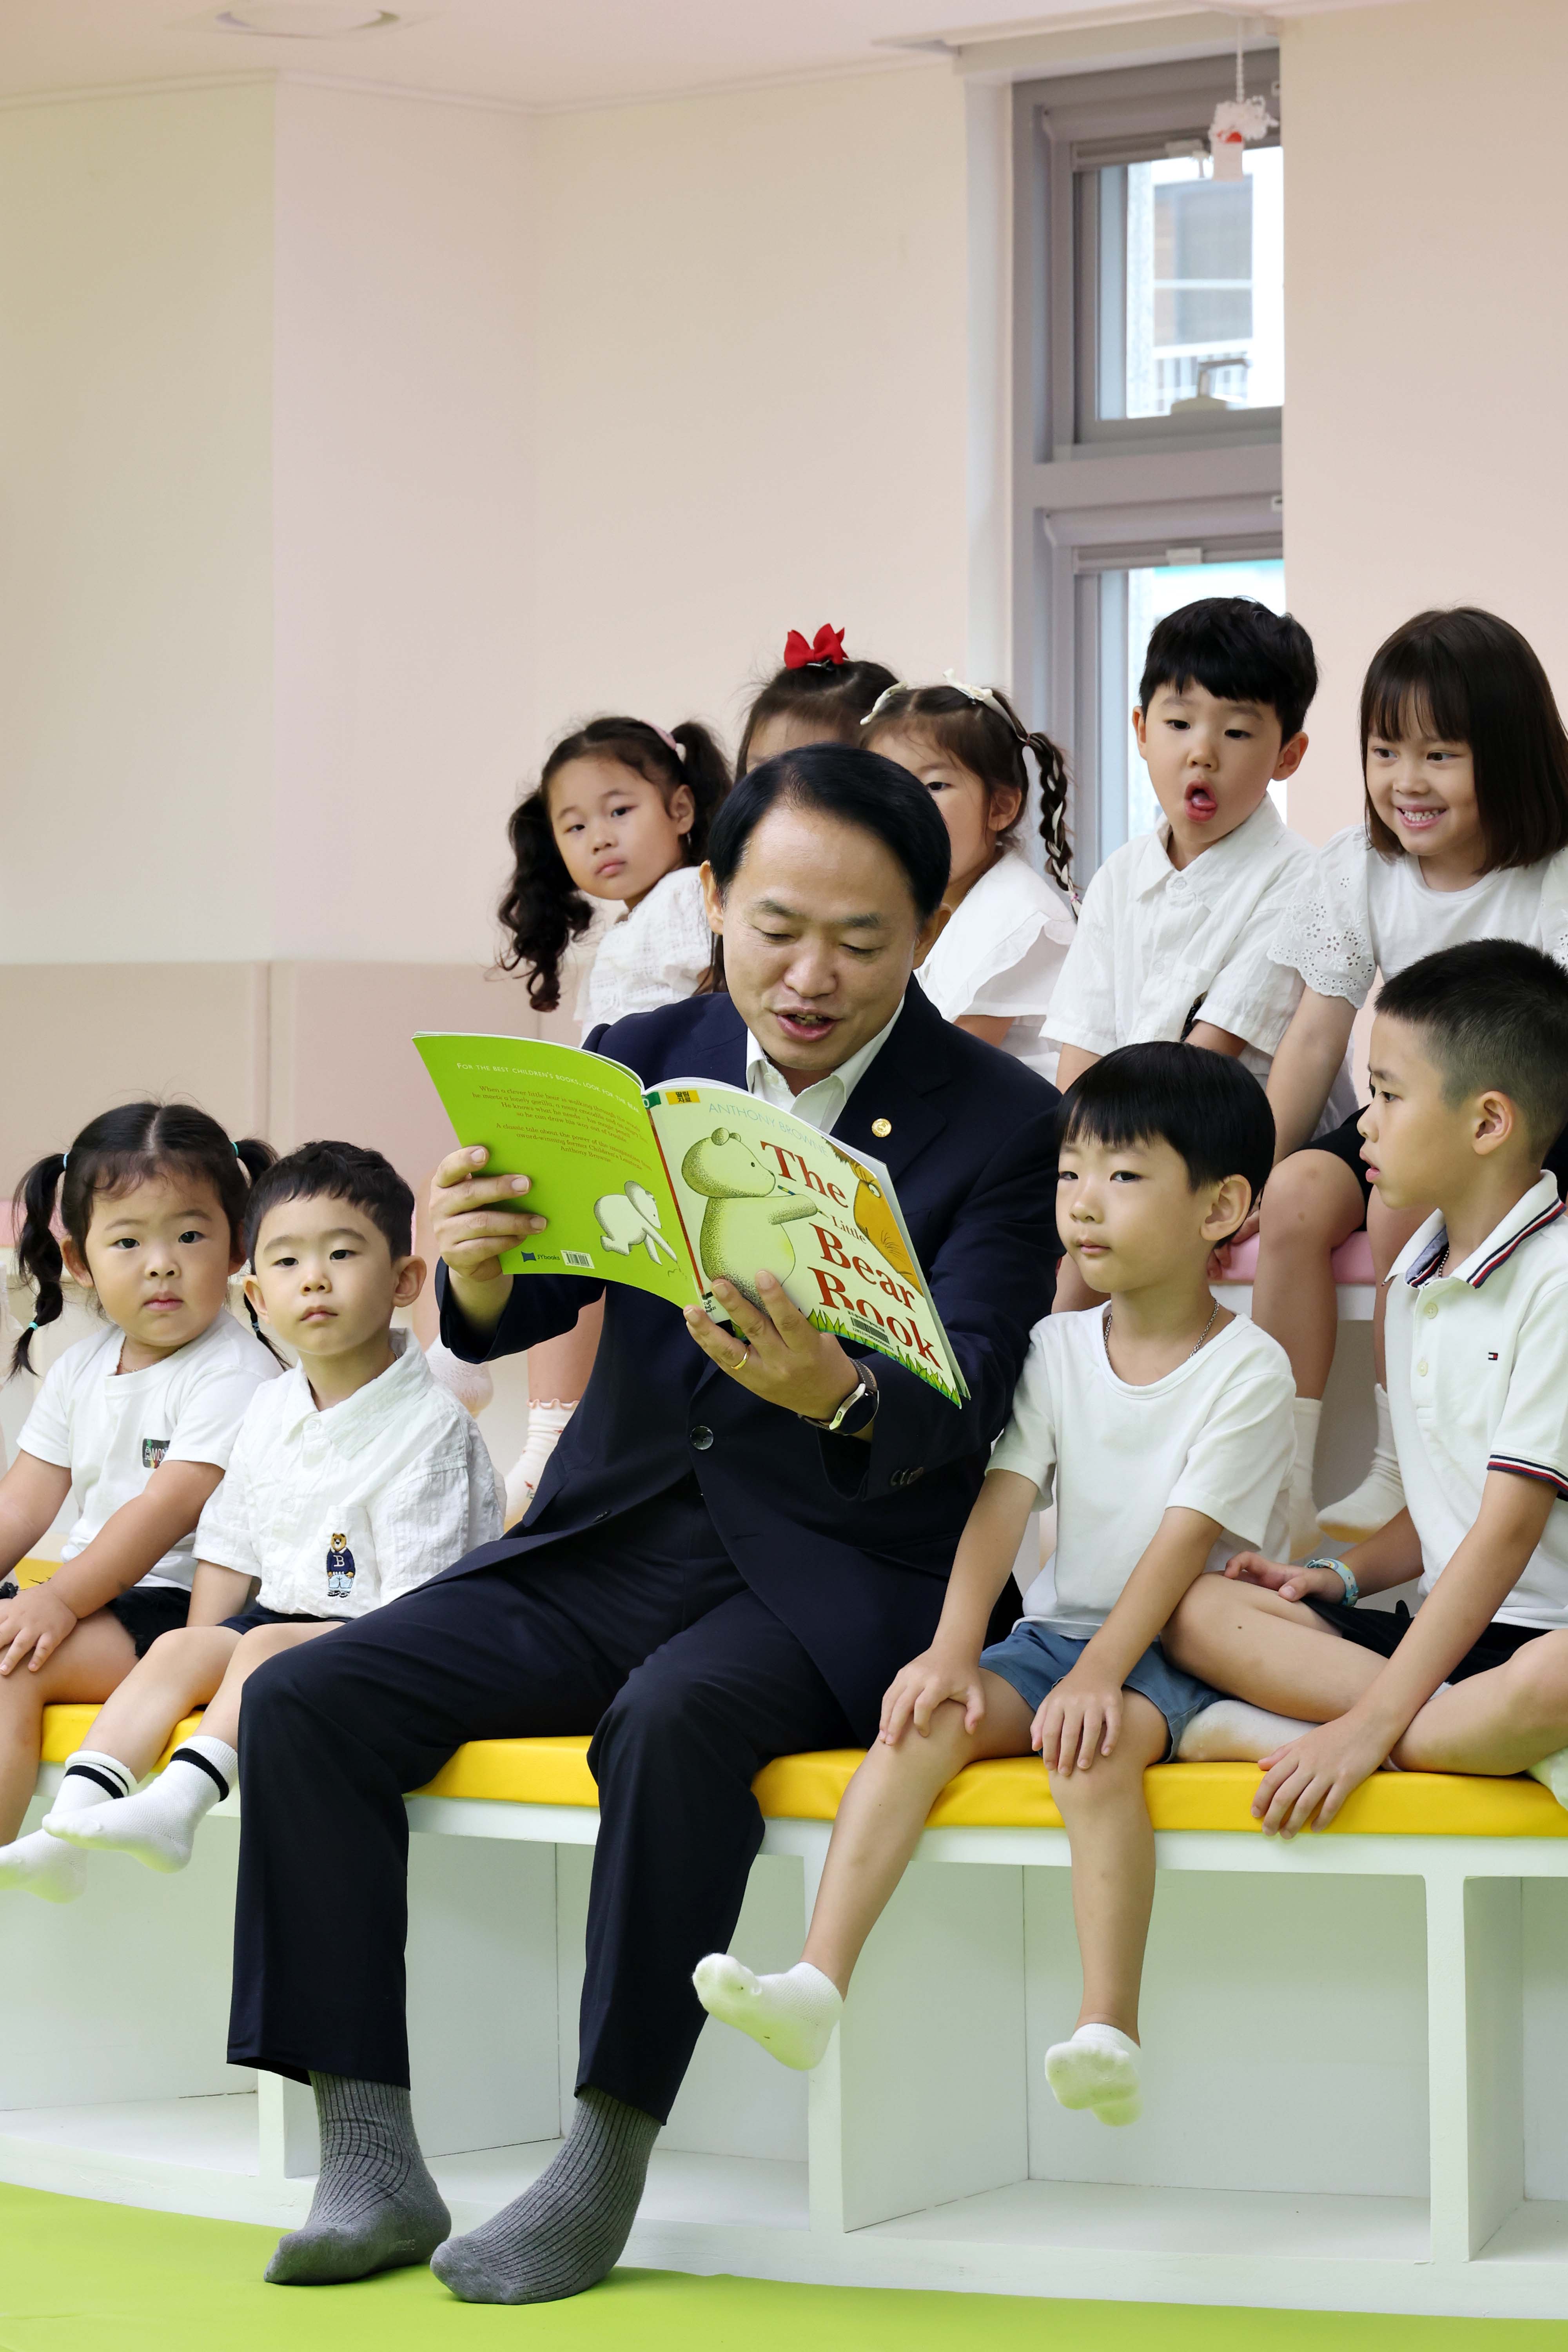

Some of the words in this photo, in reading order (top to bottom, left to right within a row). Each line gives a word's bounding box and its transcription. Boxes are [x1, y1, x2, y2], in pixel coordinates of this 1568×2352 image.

[512, 1068, 554, 1079] CHILDREN'S
[583, 1082, 601, 1092] LOOK
[602, 1089, 614, 1098] FOR
[510, 1096, 530, 1104] lonely
[579, 1109, 604, 1120] crocodile
[563, 1112, 581, 1120] needs
[568, 1100, 593, 1111] walking
[593, 1105, 616, 1118] through
[516, 1133, 566, 1145] award-winning
[566, 1139, 587, 1149] former
[572, 1135, 590, 1143] power
[709, 1103, 775, 1127] ANTHONY
[779, 1120, 828, 1158] BROWNE
[561, 1146, 587, 1156] Anthony
[760, 1140, 849, 1209] The
[831, 1216, 867, 1245] Little
[809, 1222, 916, 1313] Bear
[334, 1555, 345, 1567] B
